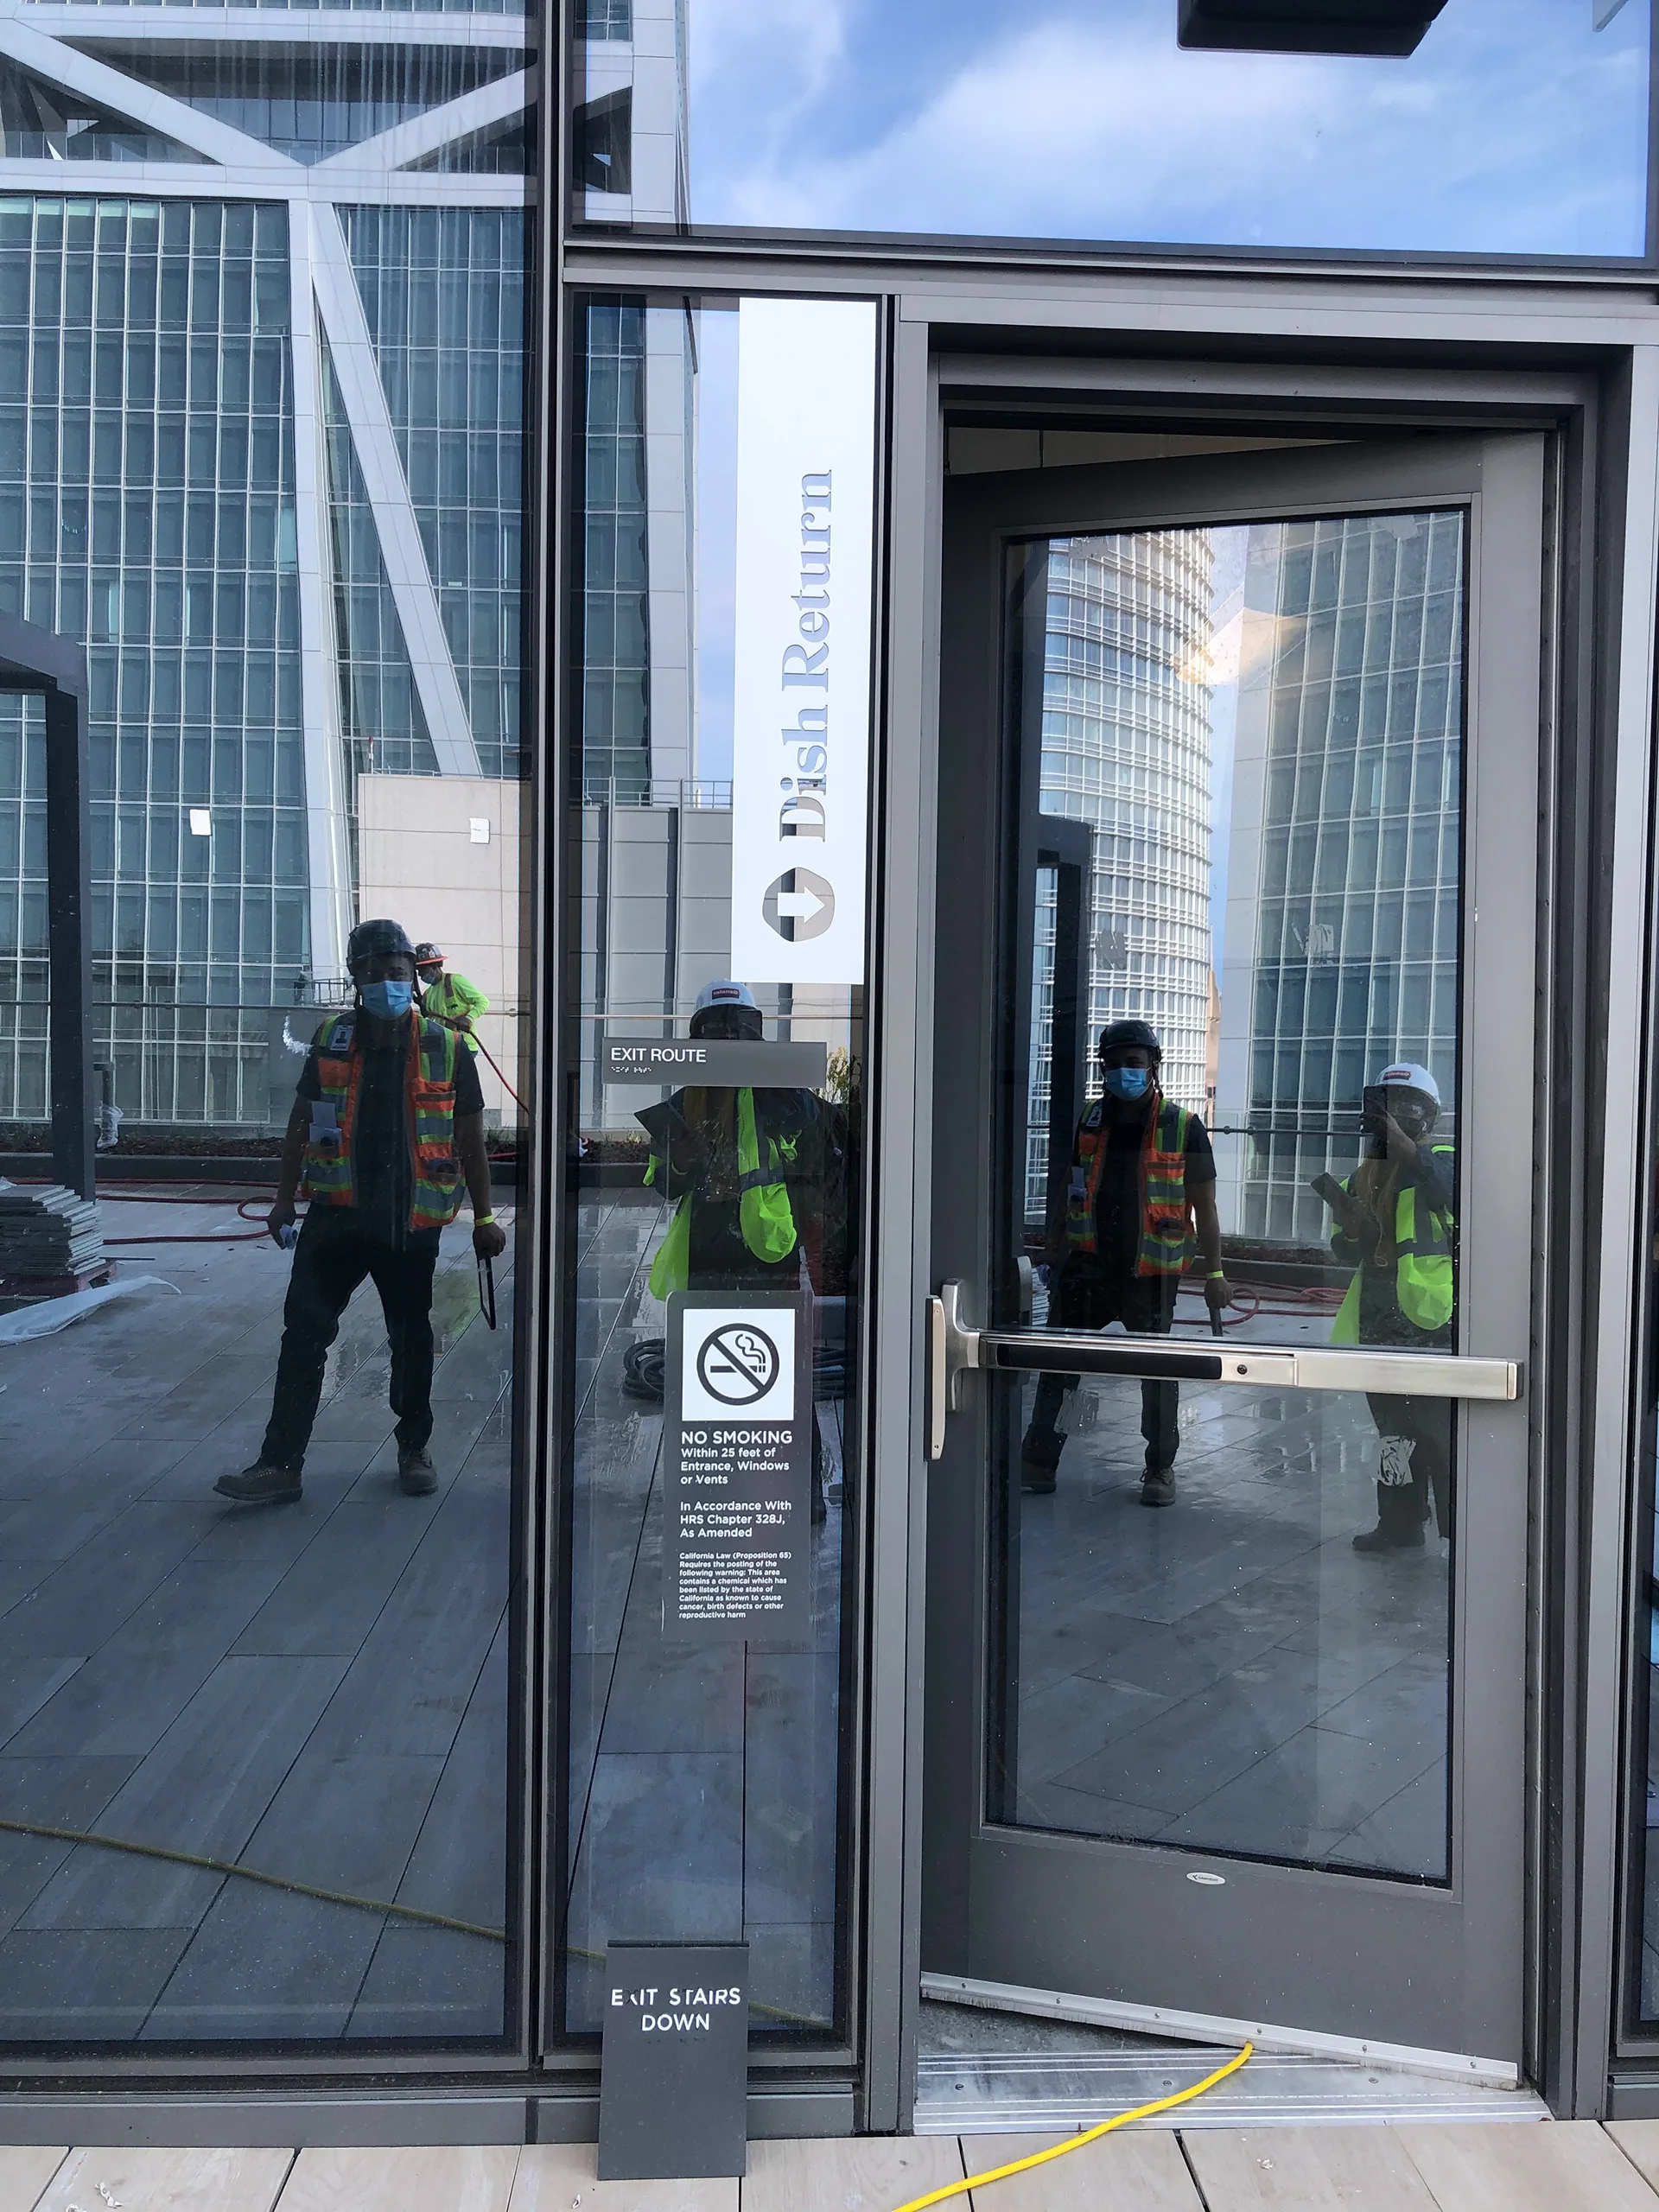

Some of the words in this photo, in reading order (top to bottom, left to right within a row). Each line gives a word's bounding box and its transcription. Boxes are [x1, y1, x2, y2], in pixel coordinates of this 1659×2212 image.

[781, 469, 831, 692] Return
[779, 704, 828, 842] Dish
[611, 1047, 647, 1061] EXIT
[651, 1048, 707, 1063] ROUTE
[682, 1431, 708, 1444] NO
[713, 1431, 792, 1444] SMOKING
[681, 1447, 718, 1458] Within
[721, 1447, 735, 1457] 25
[739, 1447, 760, 1457] feet
[764, 1447, 776, 1457] of
[681, 1461, 734, 1471] Entrance,
[737, 1460, 790, 1471] Windows
[681, 1476, 692, 1484] or
[696, 1475, 728, 1484] Vents
[680, 1501, 690, 1510] In
[694, 1501, 761, 1510] Accordance
[765, 1501, 791, 1510] With
[680, 1515, 704, 1524] HRS
[707, 1514, 753, 1525] Chapter
[755, 1514, 785, 1525] 328J,
[680, 1528, 695, 1537] As
[697, 1528, 753, 1537] Amended
[733, 1552, 778, 1560] (Proposition
[727, 1560, 753, 1569] posting
[679, 1569, 713, 1578] following
[678, 1611, 726, 1619] reproductive
[669, 1987, 741, 2006] STAIRS
[641, 2012, 710, 2031] DOWN
